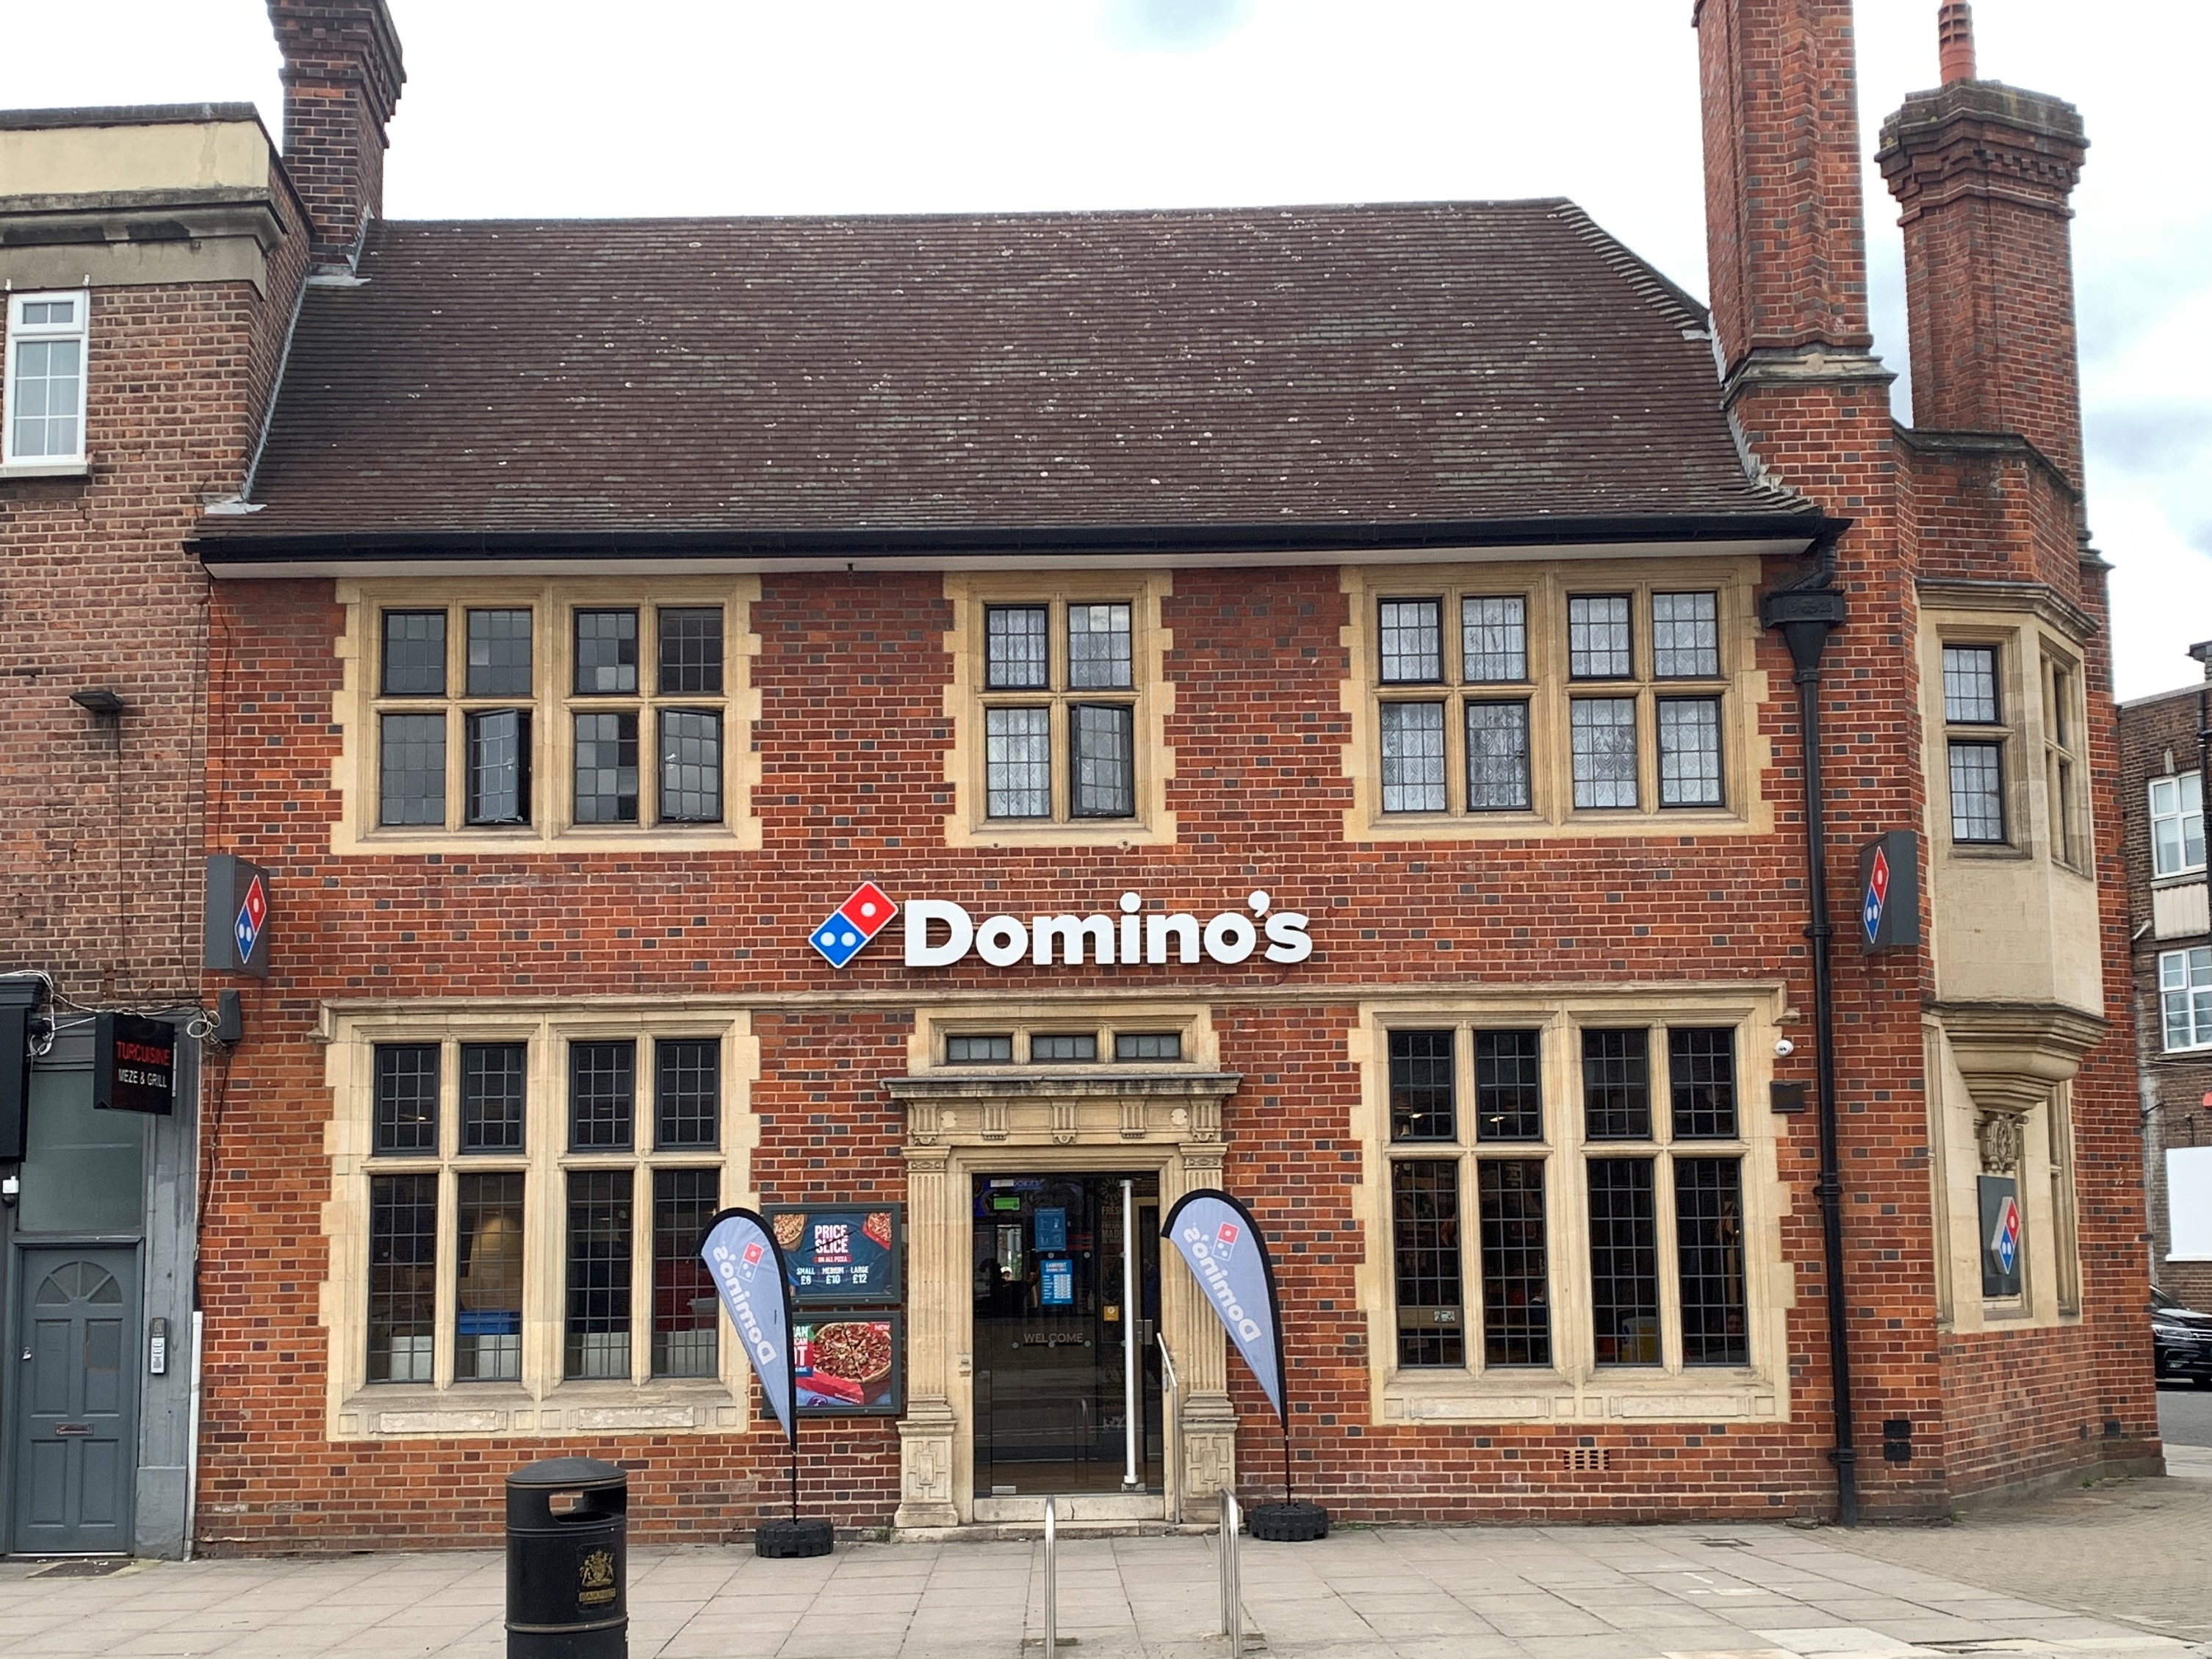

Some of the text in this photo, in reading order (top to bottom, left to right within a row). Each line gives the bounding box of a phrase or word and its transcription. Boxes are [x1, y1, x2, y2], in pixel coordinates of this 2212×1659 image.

[904, 890, 1313, 967] Domino's
[118, 1068, 167, 1088] MEZE & GRILL
[1013, 1179, 1040, 1187] OOKIES
[815, 1225, 849, 1239] PRICE
[815, 1239, 849, 1253] SLICE
[826, 1275, 840, 1284] £10
[853, 1274, 867, 1284] £12
[793, 1325, 808, 1337] AN
[1023, 1333, 1084, 1343] WELCOME
